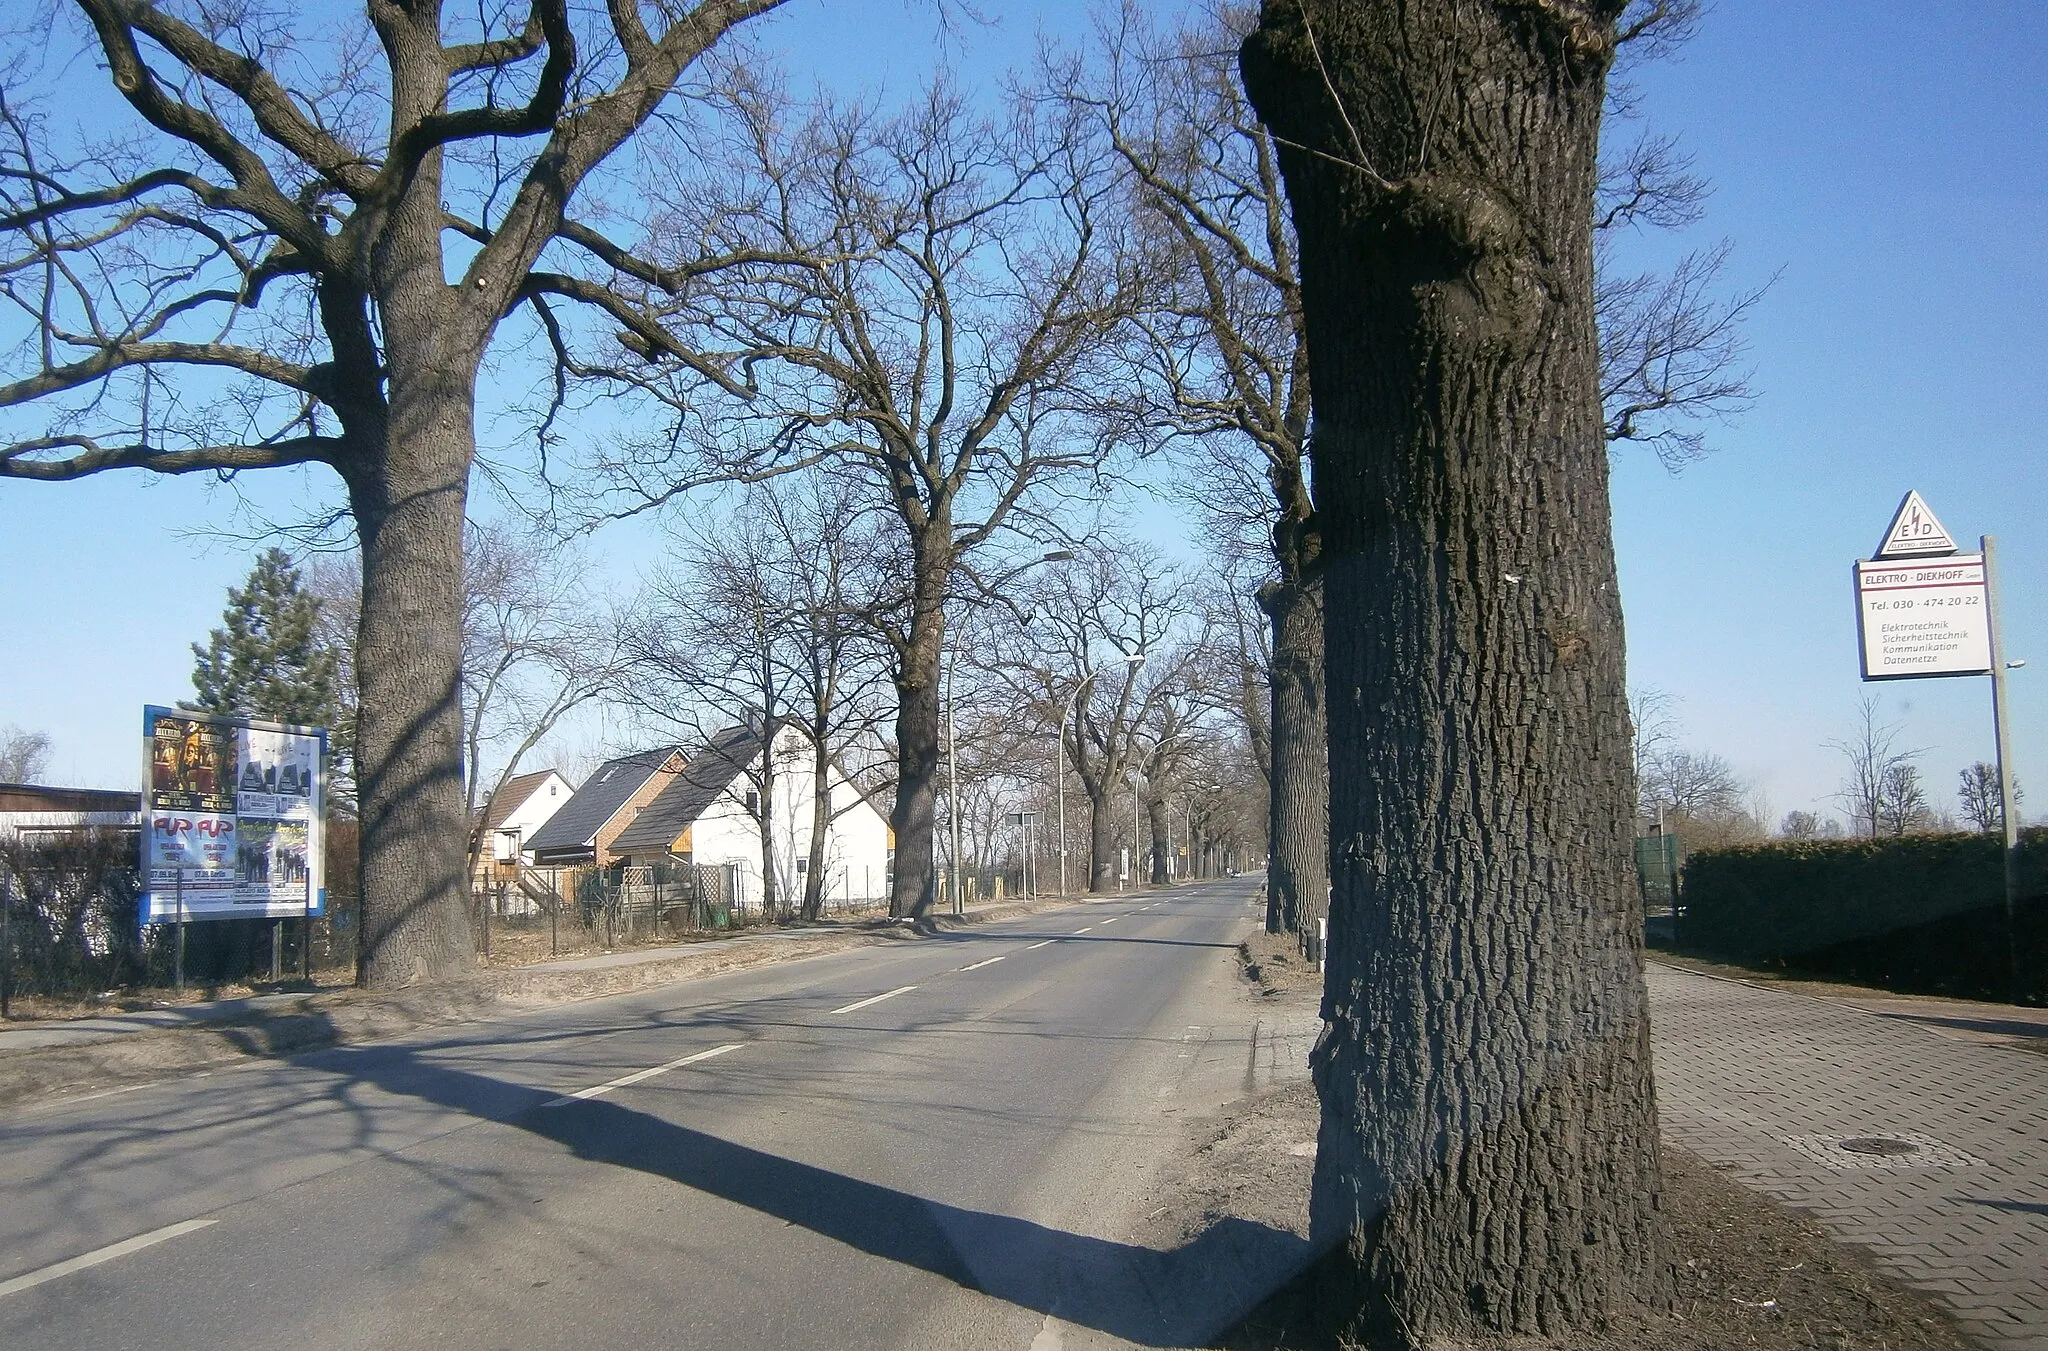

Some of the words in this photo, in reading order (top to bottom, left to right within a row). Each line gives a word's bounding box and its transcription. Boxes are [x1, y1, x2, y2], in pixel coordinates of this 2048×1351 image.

[1902, 524, 1910, 537] E
[1922, 523, 1932, 535] D
[1865, 573, 1908, 585] ELEKTRO
[1916, 570, 1963, 582] DIEKHOFF
[1870, 601, 1889, 611] Tel.
[1893, 600, 1914, 610] 030
[1923, 598, 1944, 607] 474
[1947, 597, 1961, 606] 20
[1965, 596, 1979, 605] 22
[1881, 620, 1949, 633] Elektrotechnik
[1882, 630, 1969, 643] Sicherheitstechnik
[1882, 643, 1958, 654] Kommunikation
[1883, 655, 1938, 665] Datennetze
[153, 817, 194, 841] PUR
[197, 819, 234, 840] PUR
